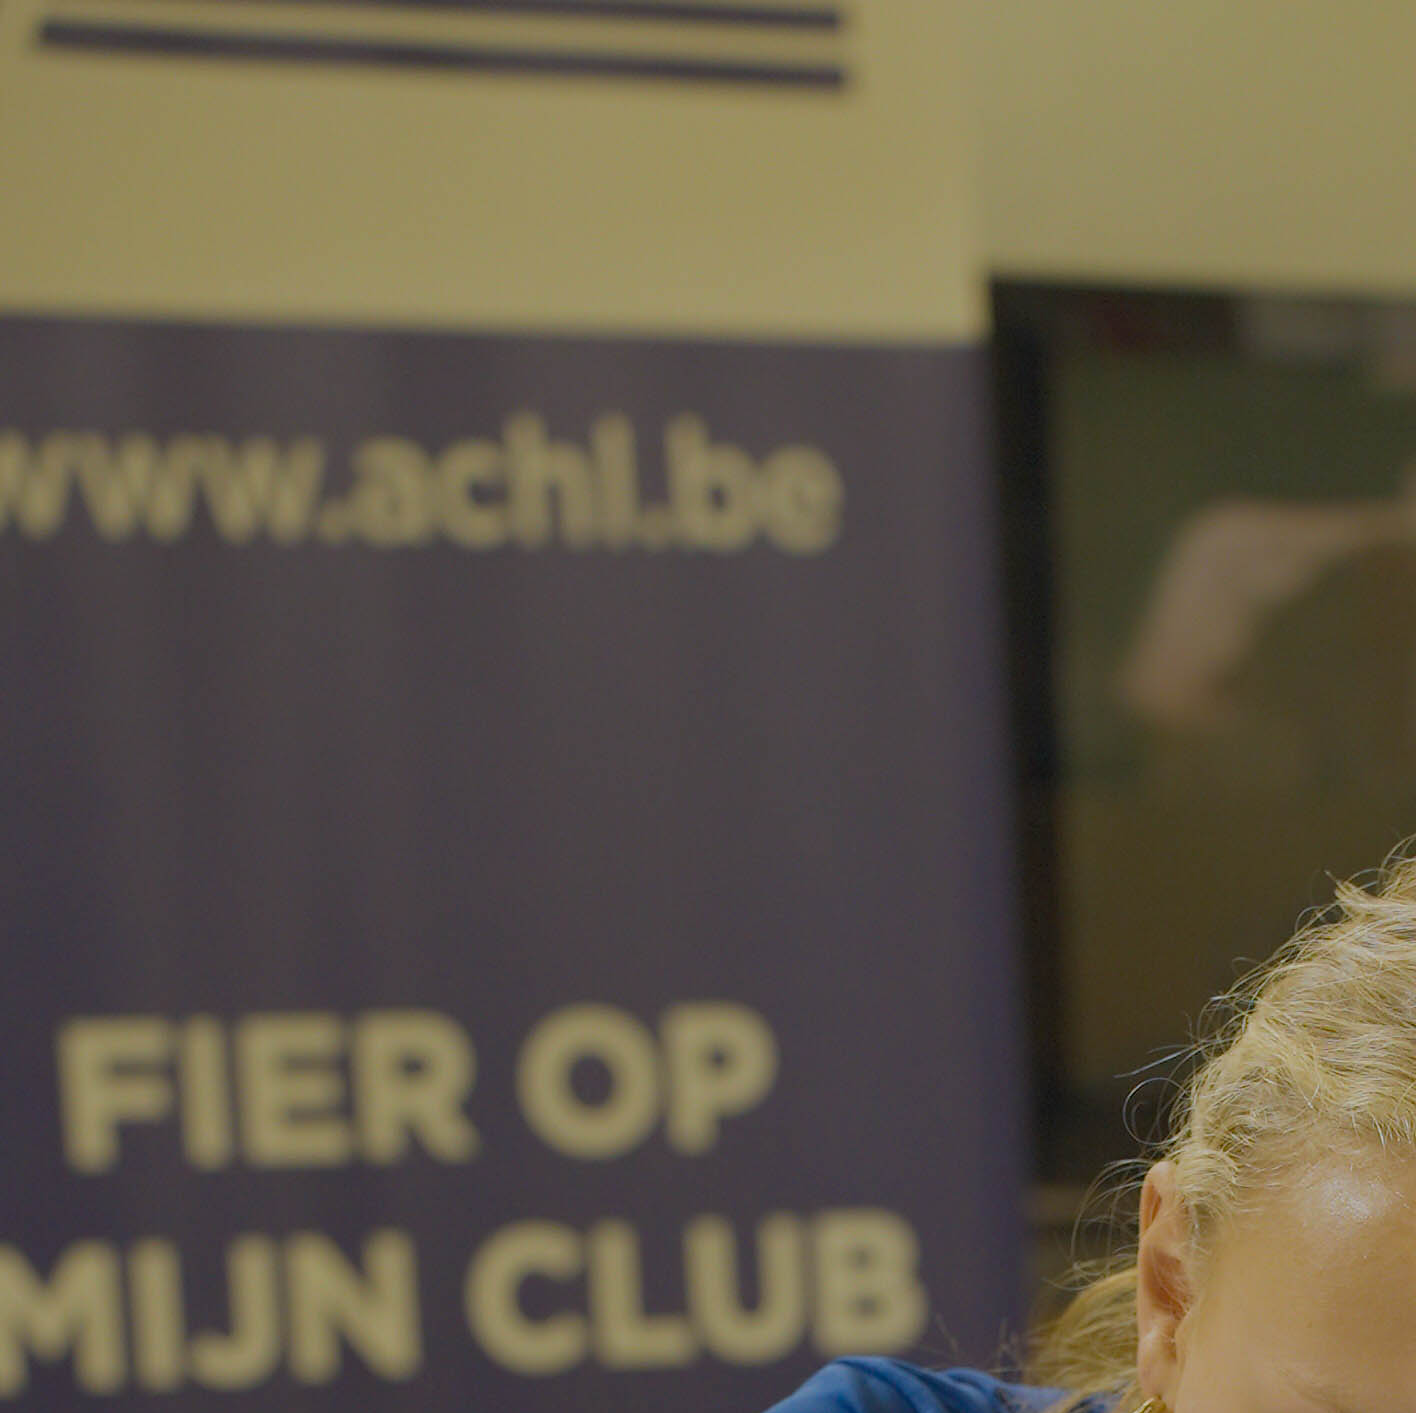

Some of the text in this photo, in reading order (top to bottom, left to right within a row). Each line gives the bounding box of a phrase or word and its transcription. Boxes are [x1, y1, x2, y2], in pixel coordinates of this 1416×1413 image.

[56, 999, 780, 1174] FIER OP
[0, 1207, 929, 1396] MIJN CLUB
